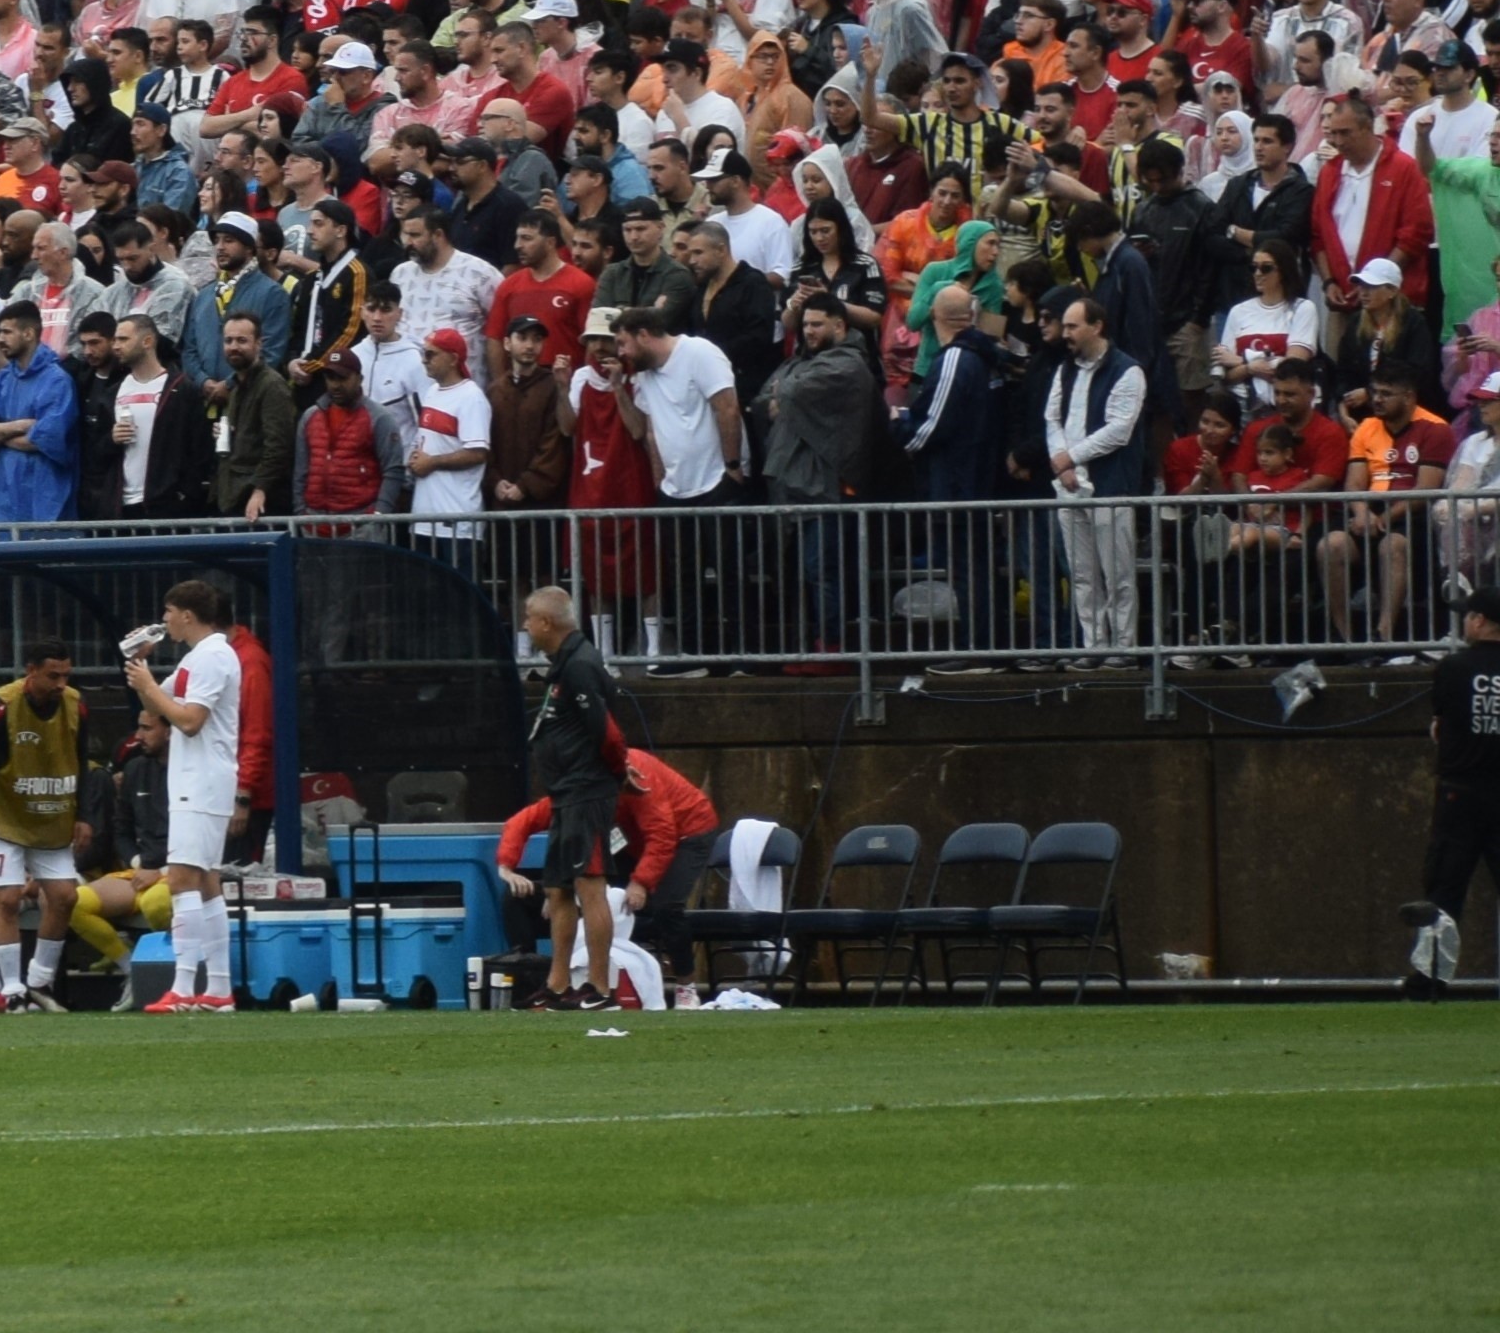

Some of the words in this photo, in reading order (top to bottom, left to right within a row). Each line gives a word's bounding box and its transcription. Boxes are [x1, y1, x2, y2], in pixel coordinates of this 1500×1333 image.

[1472, 674, 1500, 694] CS
[1472, 695, 1500, 714] EVE
[1471, 715, 1500, 735] STA
